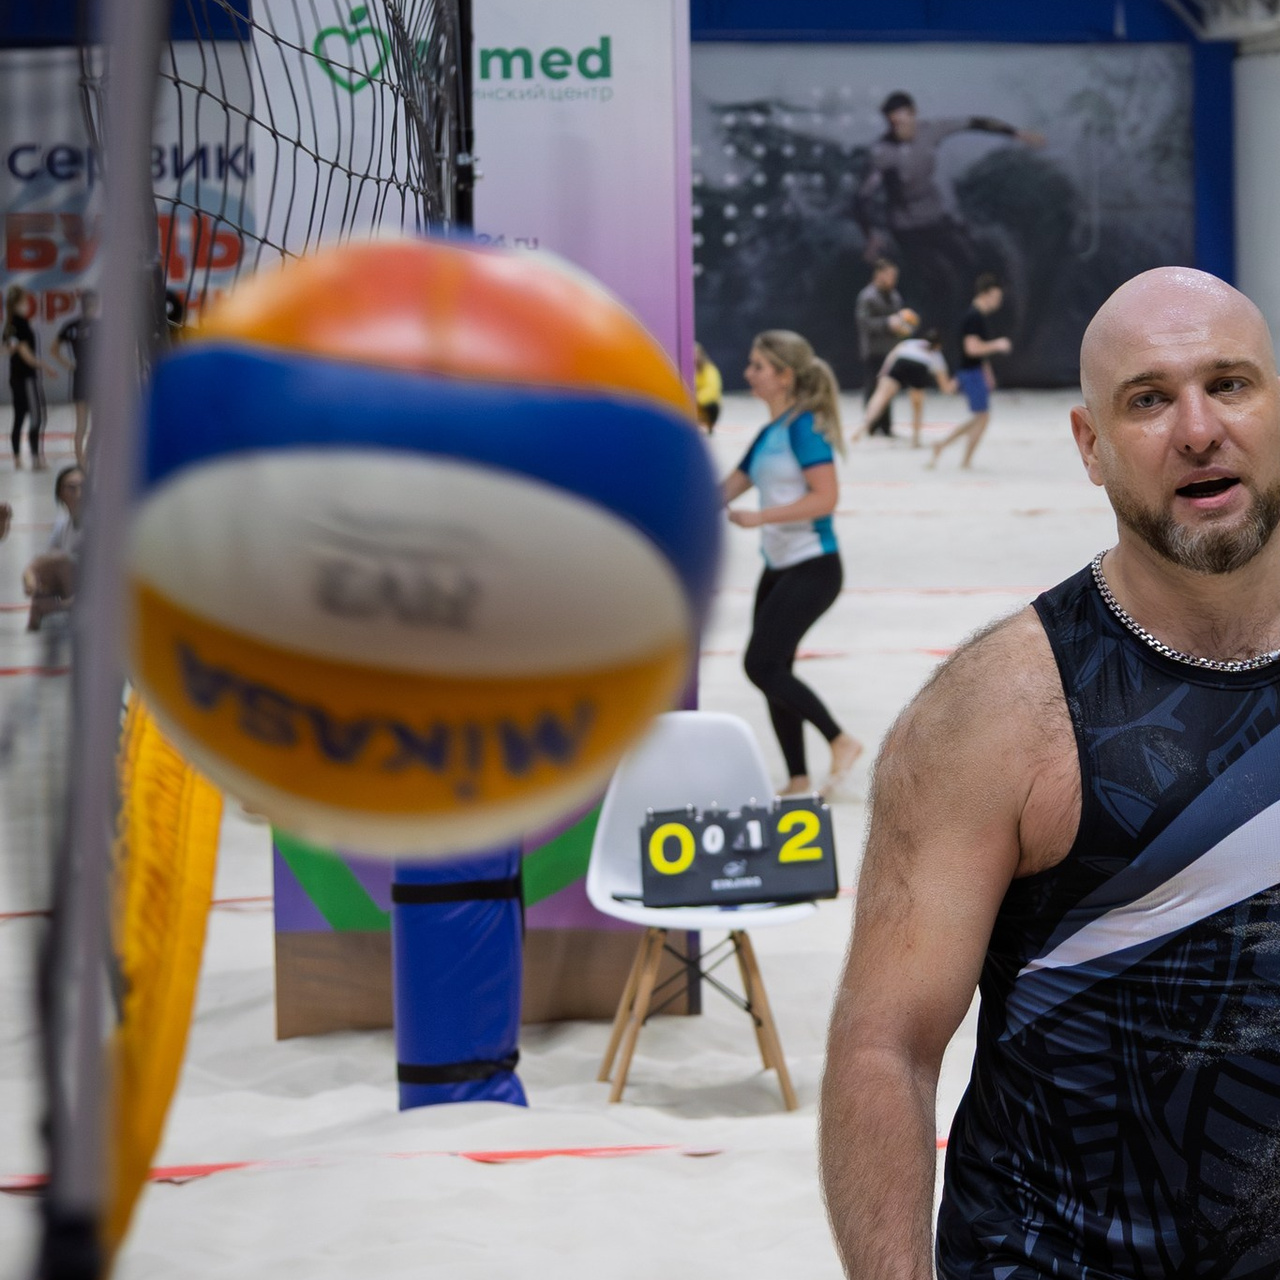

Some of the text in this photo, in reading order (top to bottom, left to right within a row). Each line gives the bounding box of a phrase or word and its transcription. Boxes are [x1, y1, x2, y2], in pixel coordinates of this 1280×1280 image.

[411, 35, 612, 80] med
[648, 822, 696, 875] 0
[702, 824, 725, 855] 0
[777, 809, 823, 863] 2
